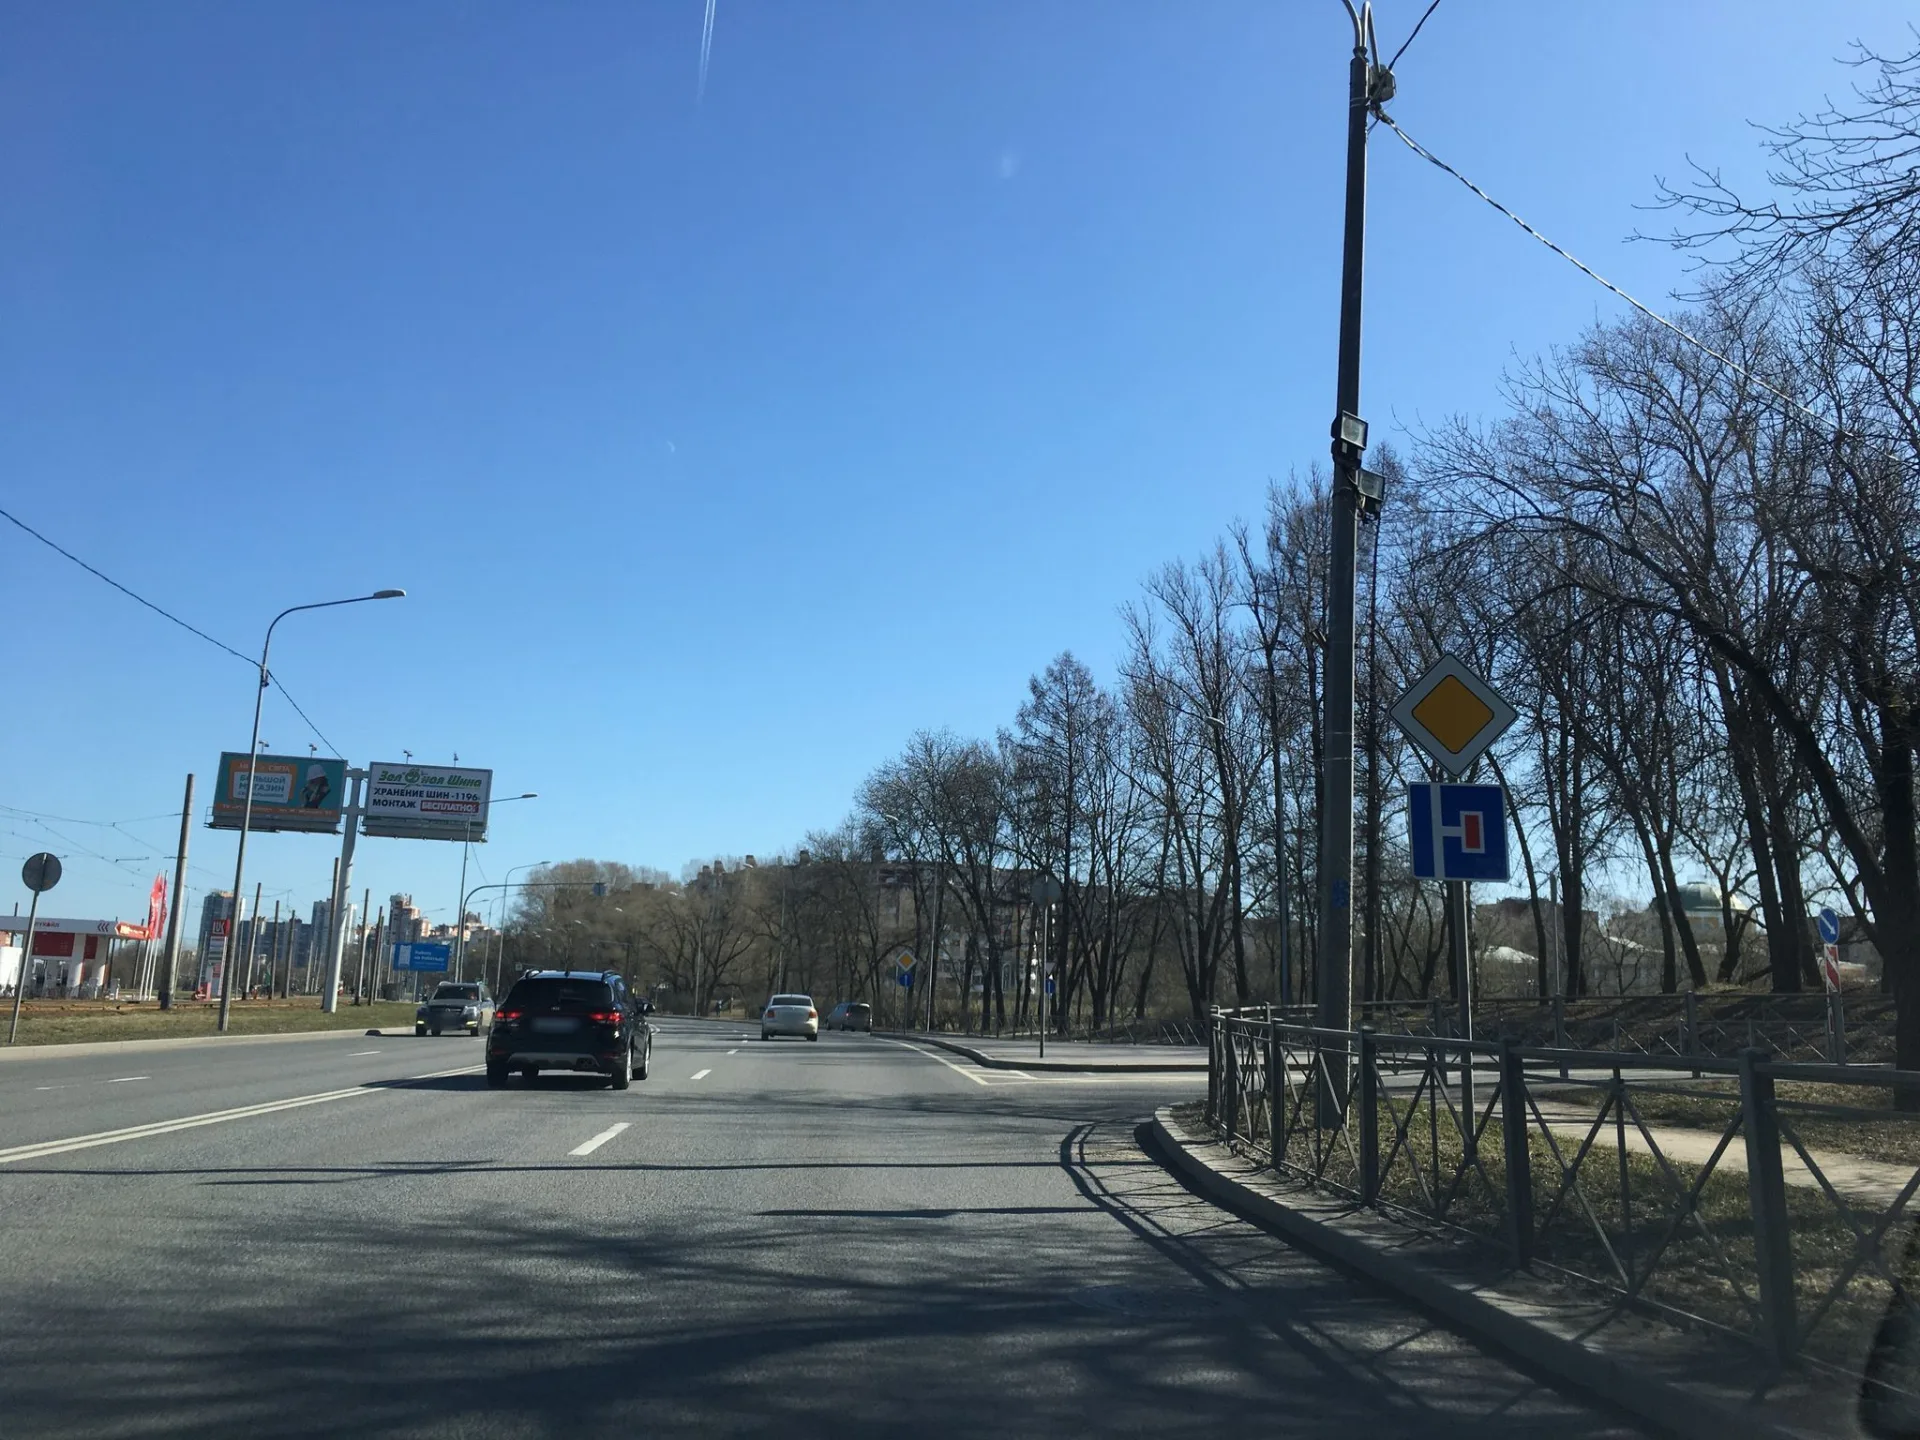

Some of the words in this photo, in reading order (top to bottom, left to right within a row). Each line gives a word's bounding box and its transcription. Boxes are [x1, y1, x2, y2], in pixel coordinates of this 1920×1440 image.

[447, 775, 482, 787] Шина
[239, 783, 285, 792] МГАЗИН
[374, 788, 424, 798] ХРАНЕНИЕ
[426, 791, 450, 799] ШИН
[373, 799, 416, 809] МОНТАЖ
